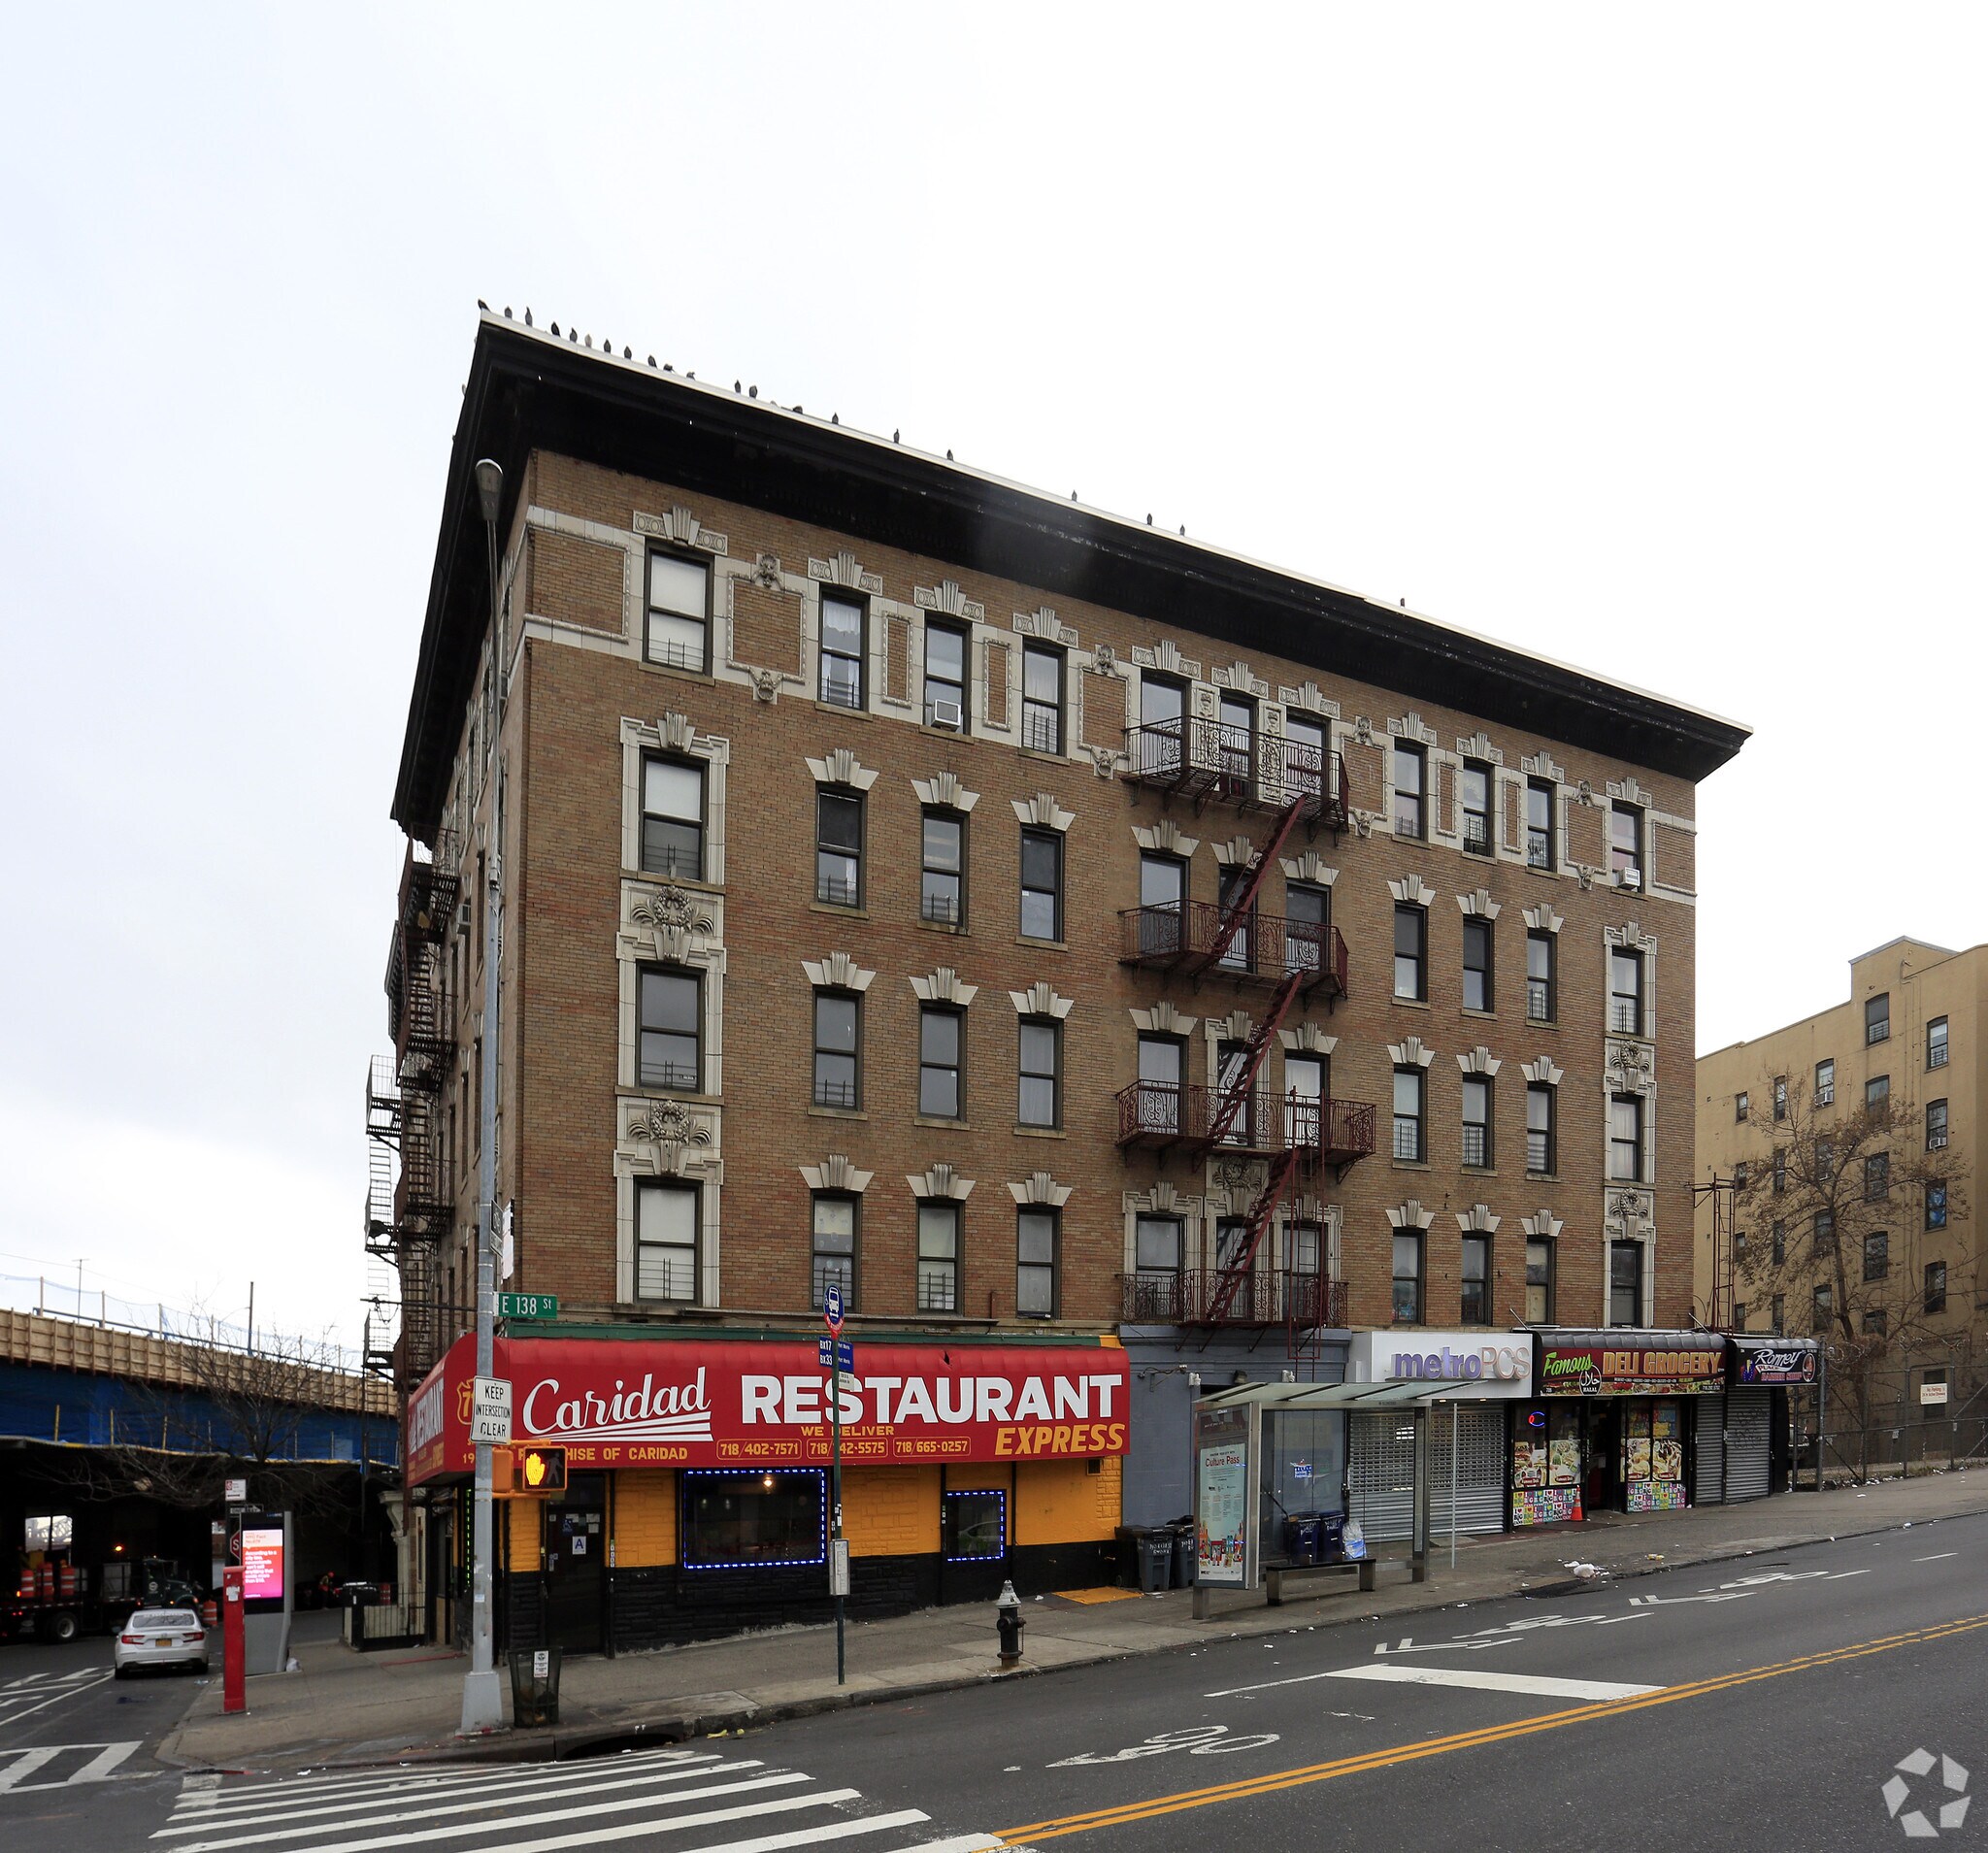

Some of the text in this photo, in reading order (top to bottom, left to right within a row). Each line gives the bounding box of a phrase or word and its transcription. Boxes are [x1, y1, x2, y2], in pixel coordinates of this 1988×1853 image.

[502, 1296, 551, 1315] E 138 St
[1543, 1351, 1593, 1376] Famous
[1603, 1352, 1721, 1374] DELI GROCERY
[485, 1385, 504, 1400] KEEP
[522, 1366, 712, 1435] Caridad
[741, 1373, 1122, 1425] RESTAURANT
[476, 1404, 511, 1418] INTERSECTION
[480, 1422, 506, 1437] CLEAR
[801, 1426, 824, 1437] WE
[994, 1423, 1125, 1456] EXPRESS
[603, 1447, 620, 1461] OF
[629, 1446, 688, 1461] CARIDAD
[720, 1441, 799, 1457] 718/402-7571
[896, 1440, 968, 1454] 718/665-0257
[1206, 1455, 1240, 1467] Culture Pass
[575, 1539, 583, 1549] A
